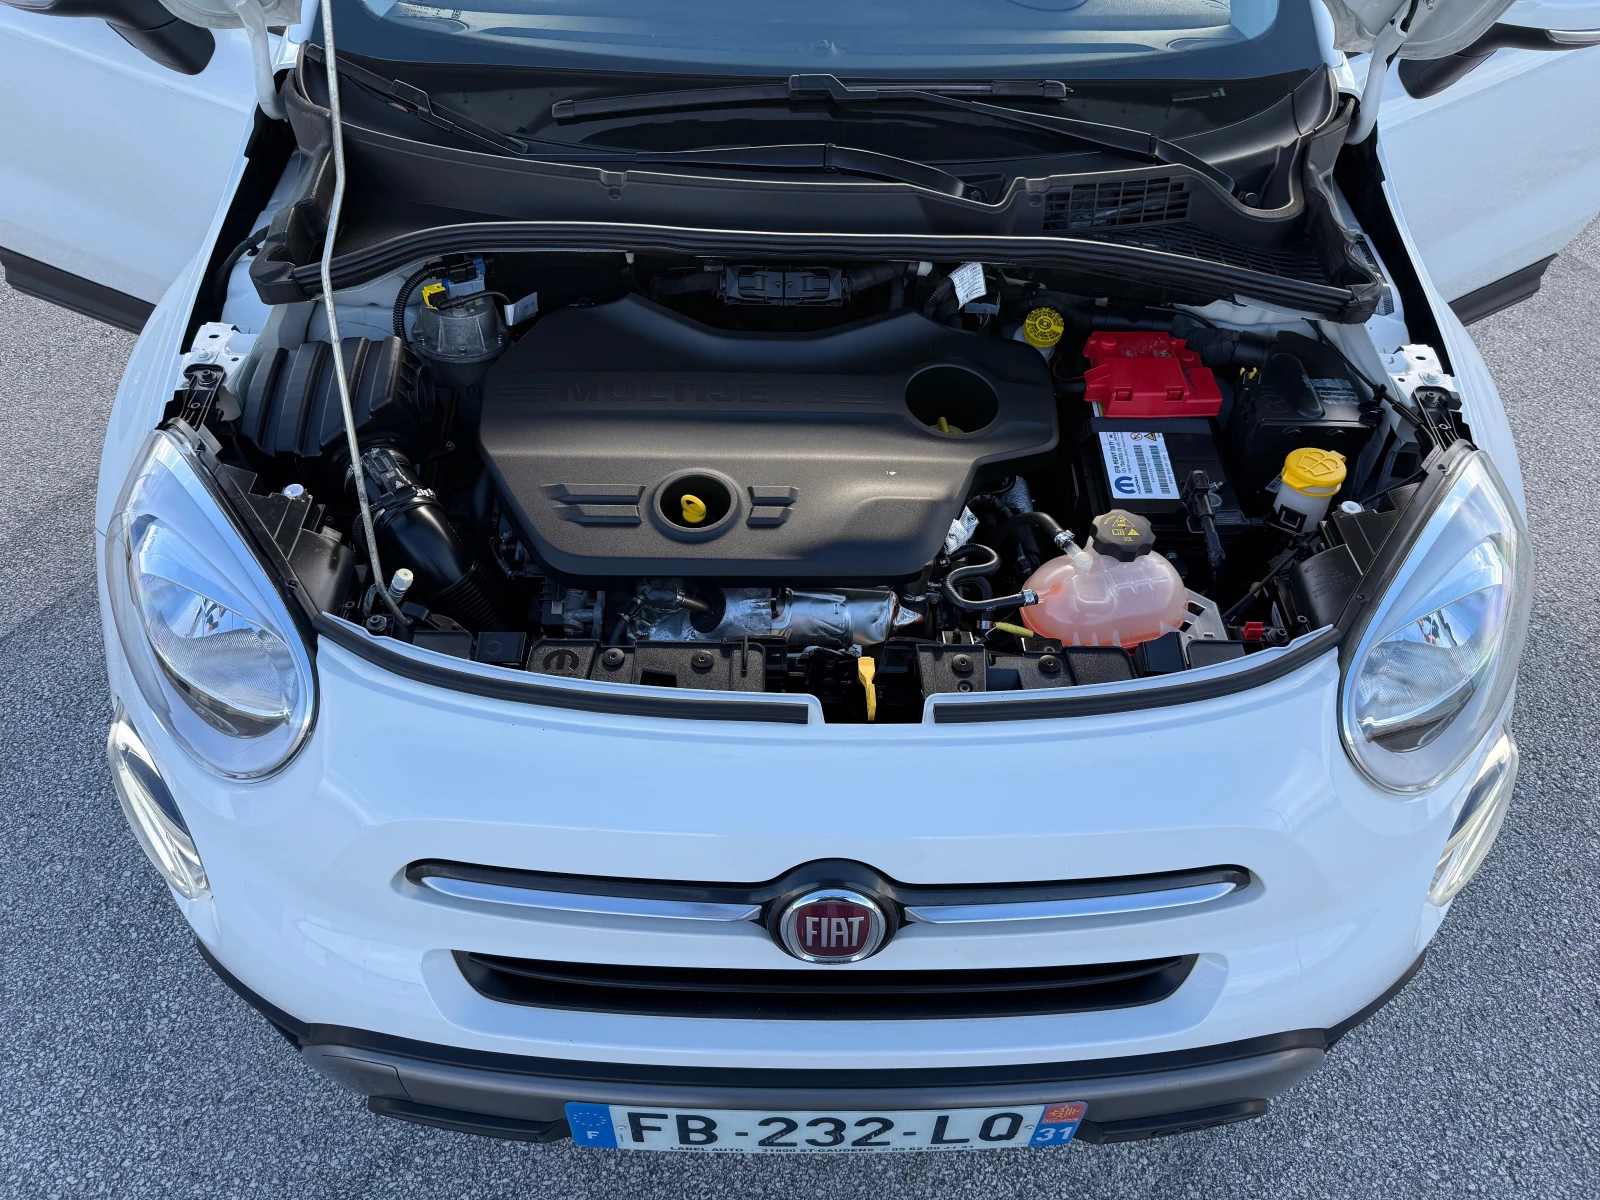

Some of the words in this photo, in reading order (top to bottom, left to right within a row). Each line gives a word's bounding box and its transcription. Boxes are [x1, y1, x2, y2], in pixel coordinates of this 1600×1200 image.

[558, 378, 796, 403] MULTIJET
[806, 916, 864, 947] FIAT
[586, 1130, 600, 1140] F
[1035, 1126, 1073, 1142] 31
